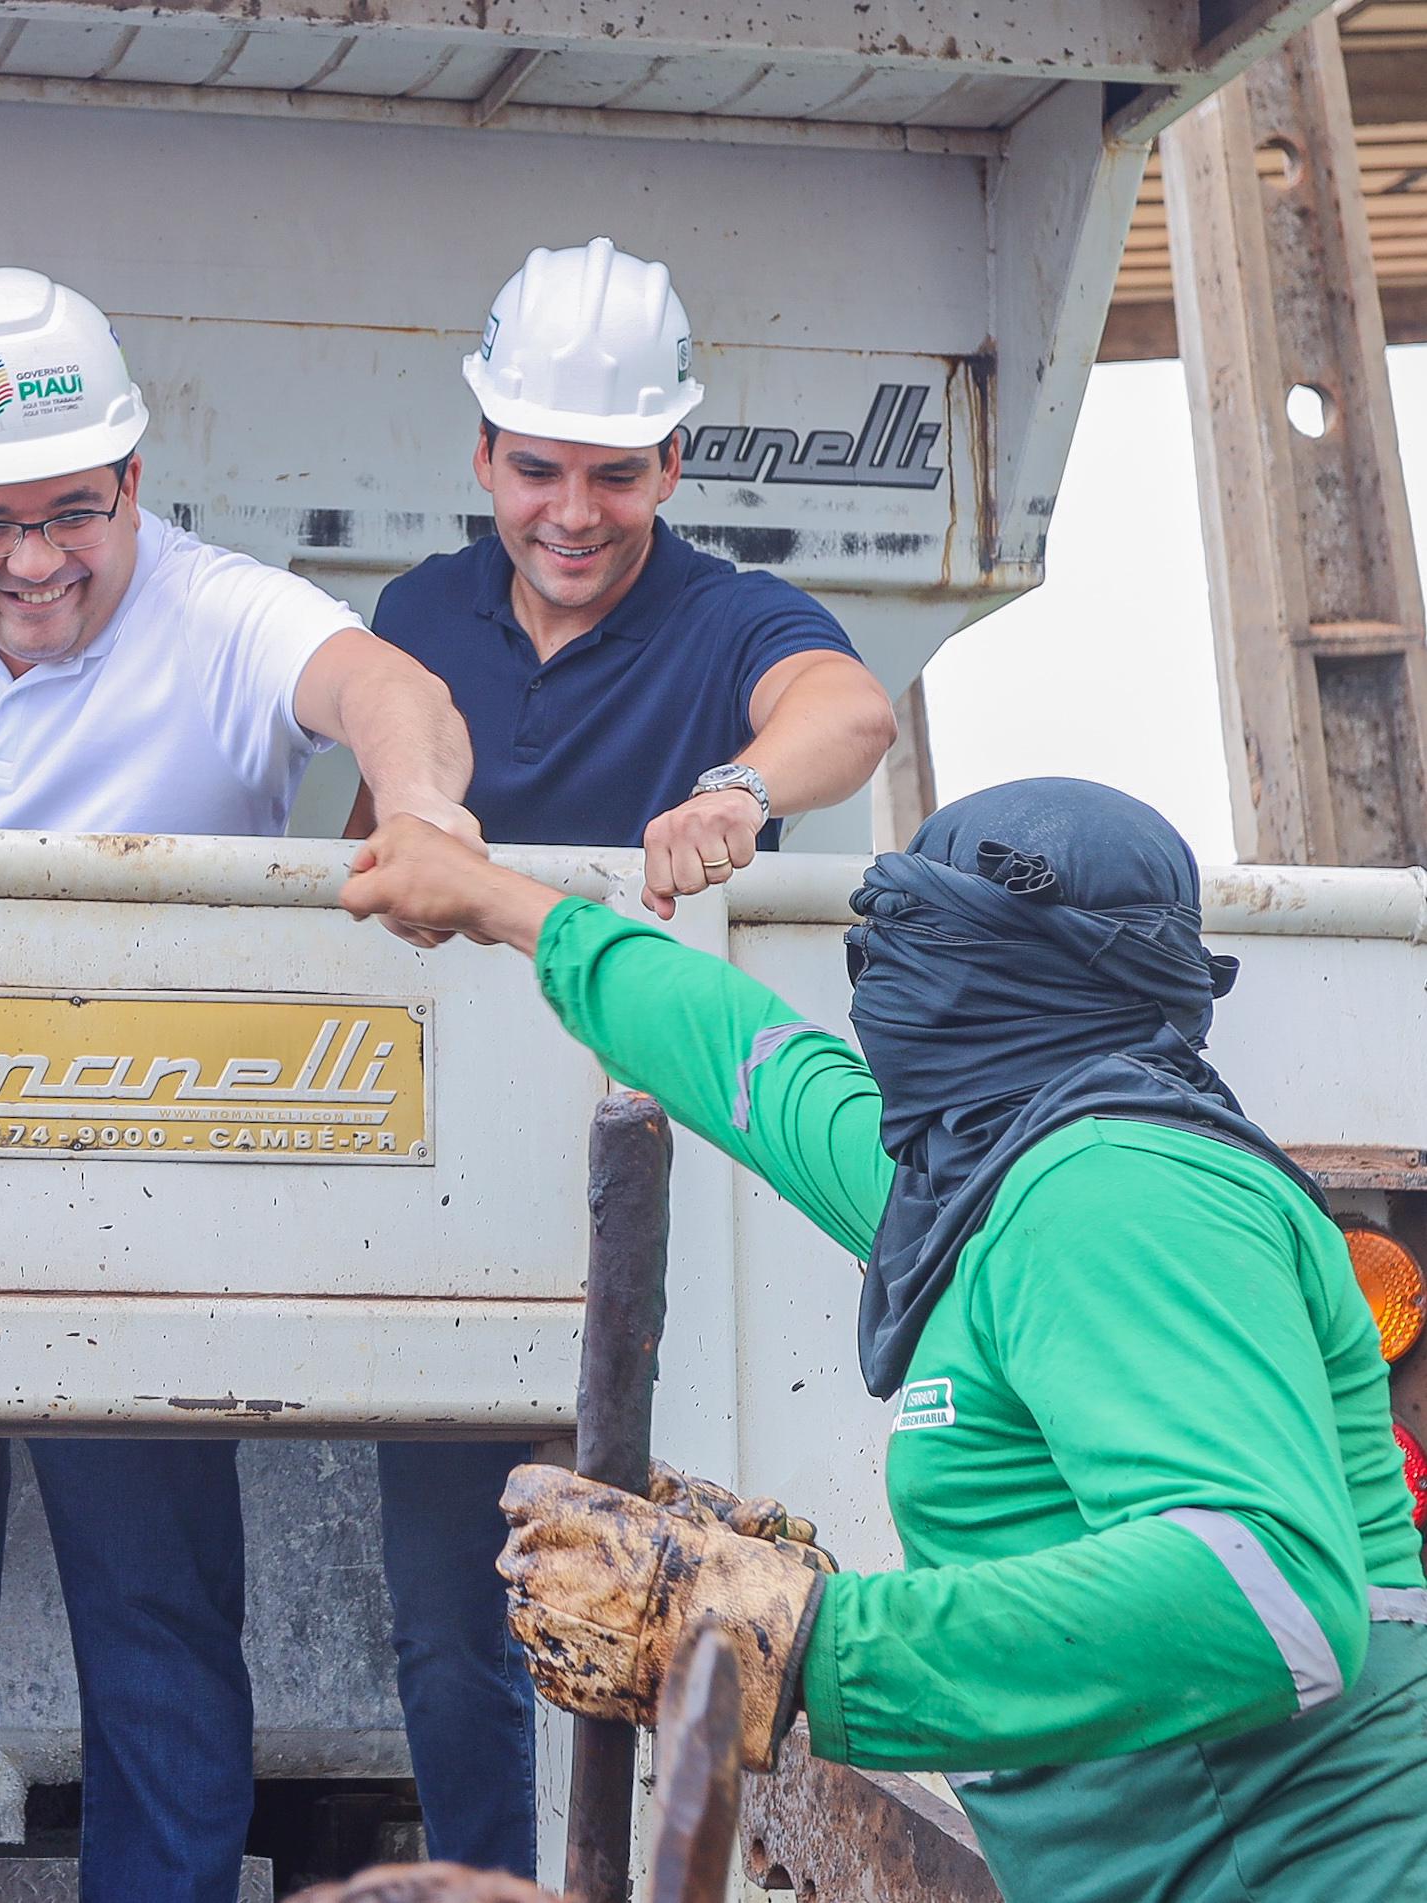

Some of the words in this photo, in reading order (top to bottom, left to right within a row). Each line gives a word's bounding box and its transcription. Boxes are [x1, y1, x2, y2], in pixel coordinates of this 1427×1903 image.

[16, 366, 64, 381] GOVERNO
[66, 364, 79, 373] DO
[208, 1125, 398, 1151] CAMBÉ-PR
